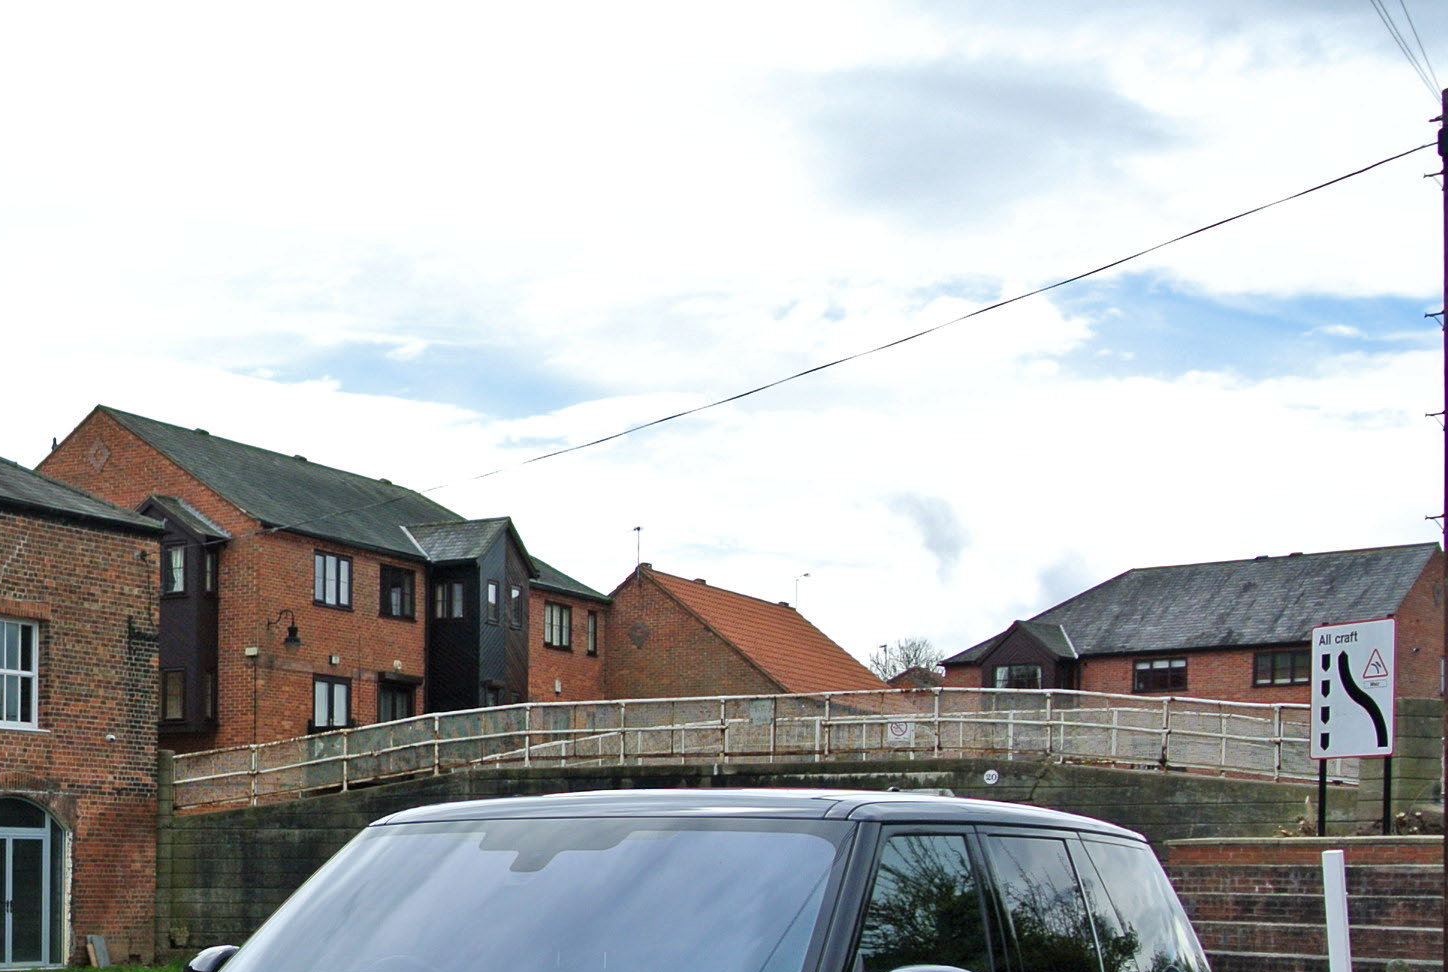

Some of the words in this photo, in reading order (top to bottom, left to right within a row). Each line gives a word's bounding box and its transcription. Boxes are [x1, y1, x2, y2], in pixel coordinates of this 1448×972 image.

[1319, 635, 1331, 646] All
[1335, 631, 1358, 644] craft
[985, 773, 997, 781] 20
